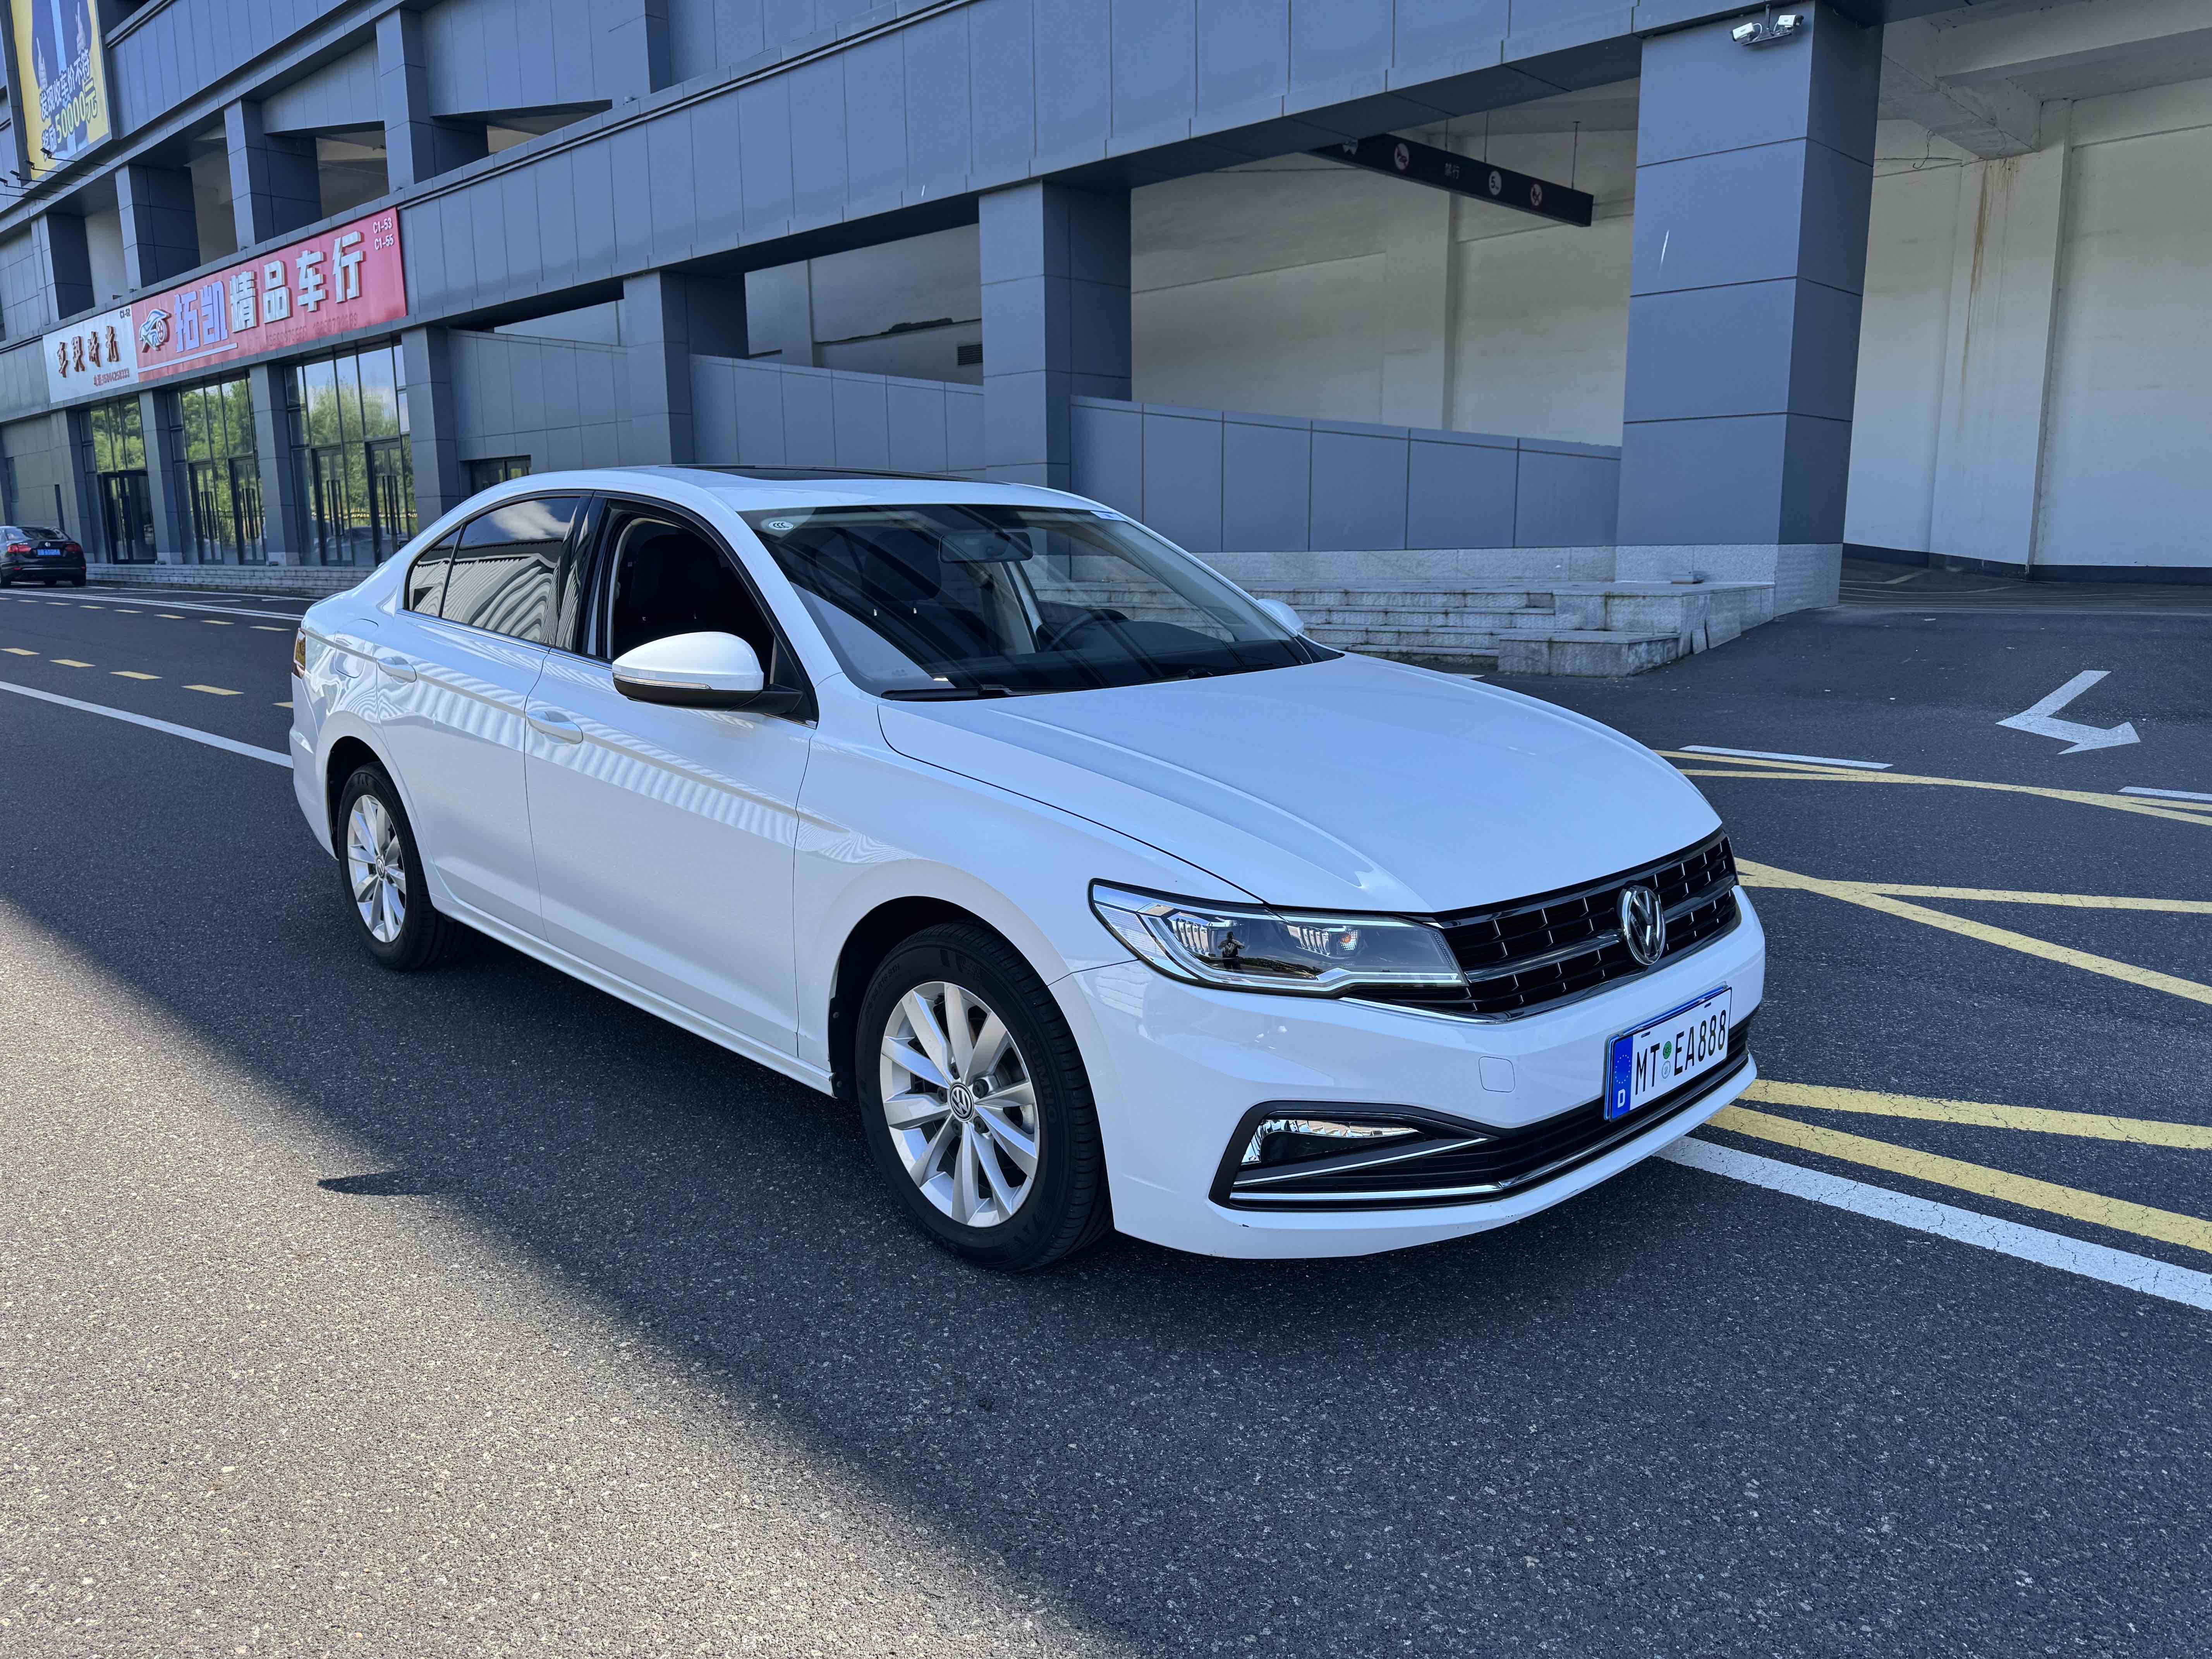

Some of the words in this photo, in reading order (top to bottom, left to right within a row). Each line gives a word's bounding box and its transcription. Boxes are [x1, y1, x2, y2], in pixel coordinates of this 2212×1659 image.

[40, 49, 90, 120] 发现收车价不符
[373, 217, 393, 234] C1-53
[374, 234, 394, 251] C1-55
[1635, 1042, 1660, 1096] MT
[1674, 1010, 1726, 1076] EA888
[1022, 1032, 1057, 1125] KUMHO
[1617, 1089, 1626, 1108] D
